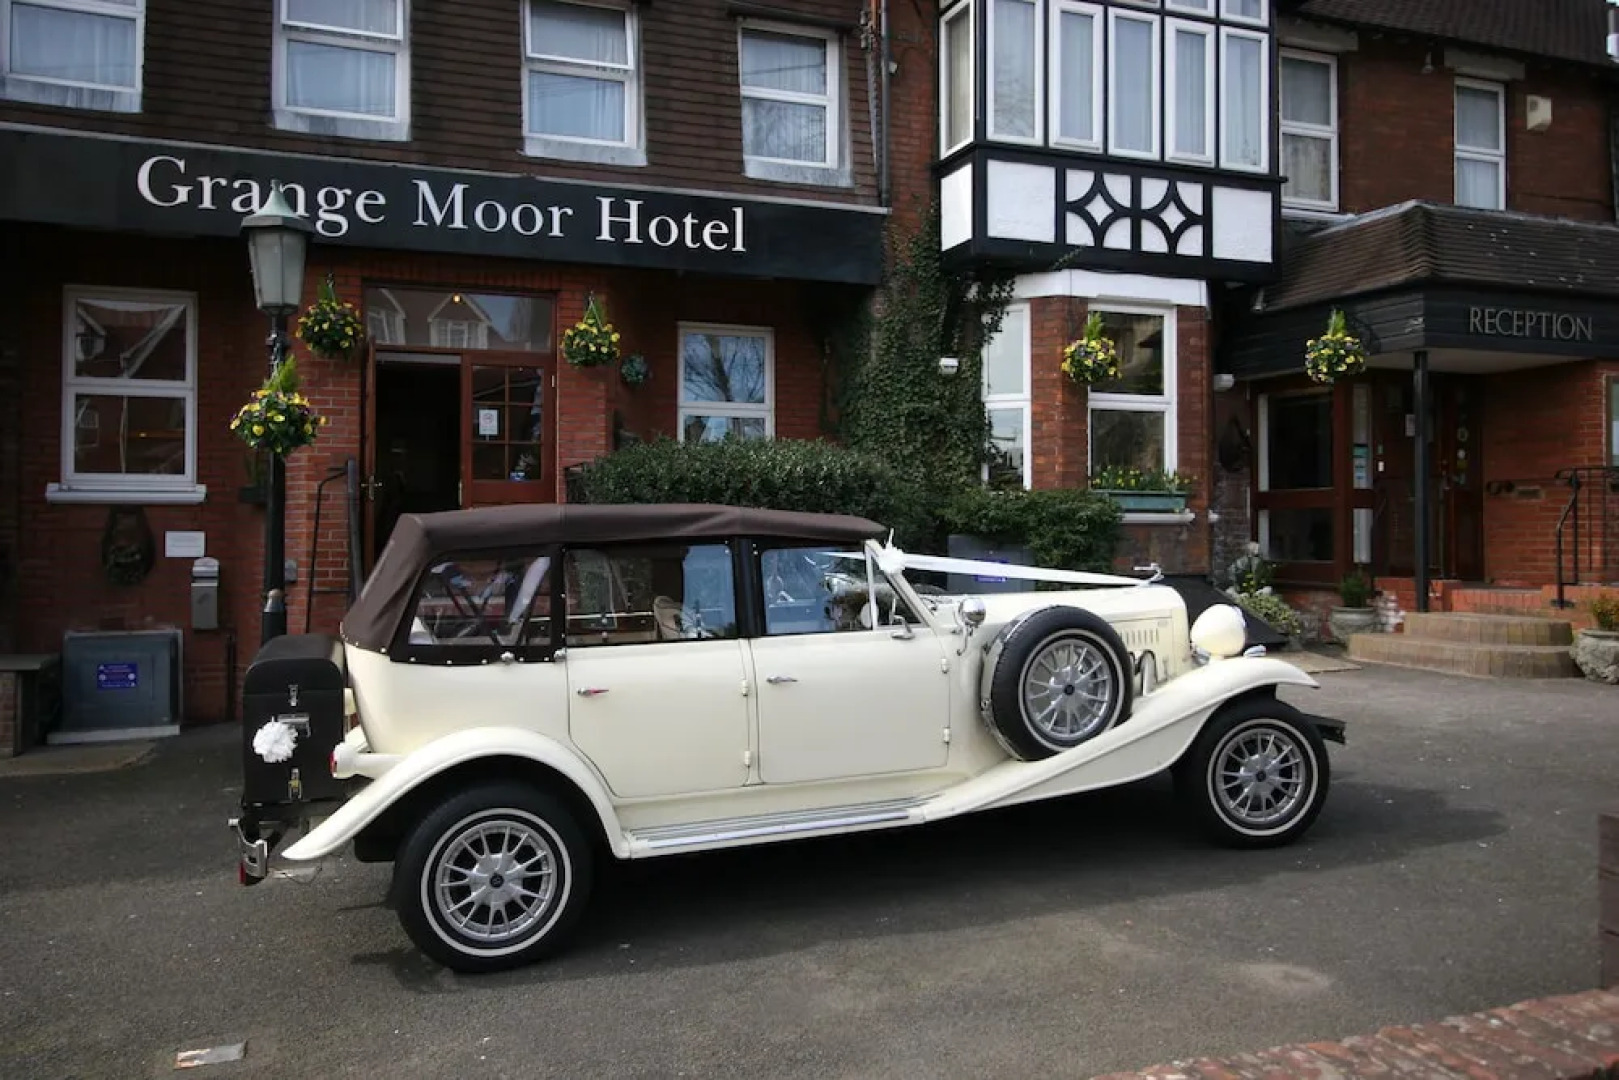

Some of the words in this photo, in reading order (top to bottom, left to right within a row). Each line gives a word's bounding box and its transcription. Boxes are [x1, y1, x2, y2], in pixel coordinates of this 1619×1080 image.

[136, 155, 387, 237] Grange
[411, 179, 574, 237] Moor
[595, 196, 746, 252] Hotel
[1469, 306, 1593, 341] RECEPTION
